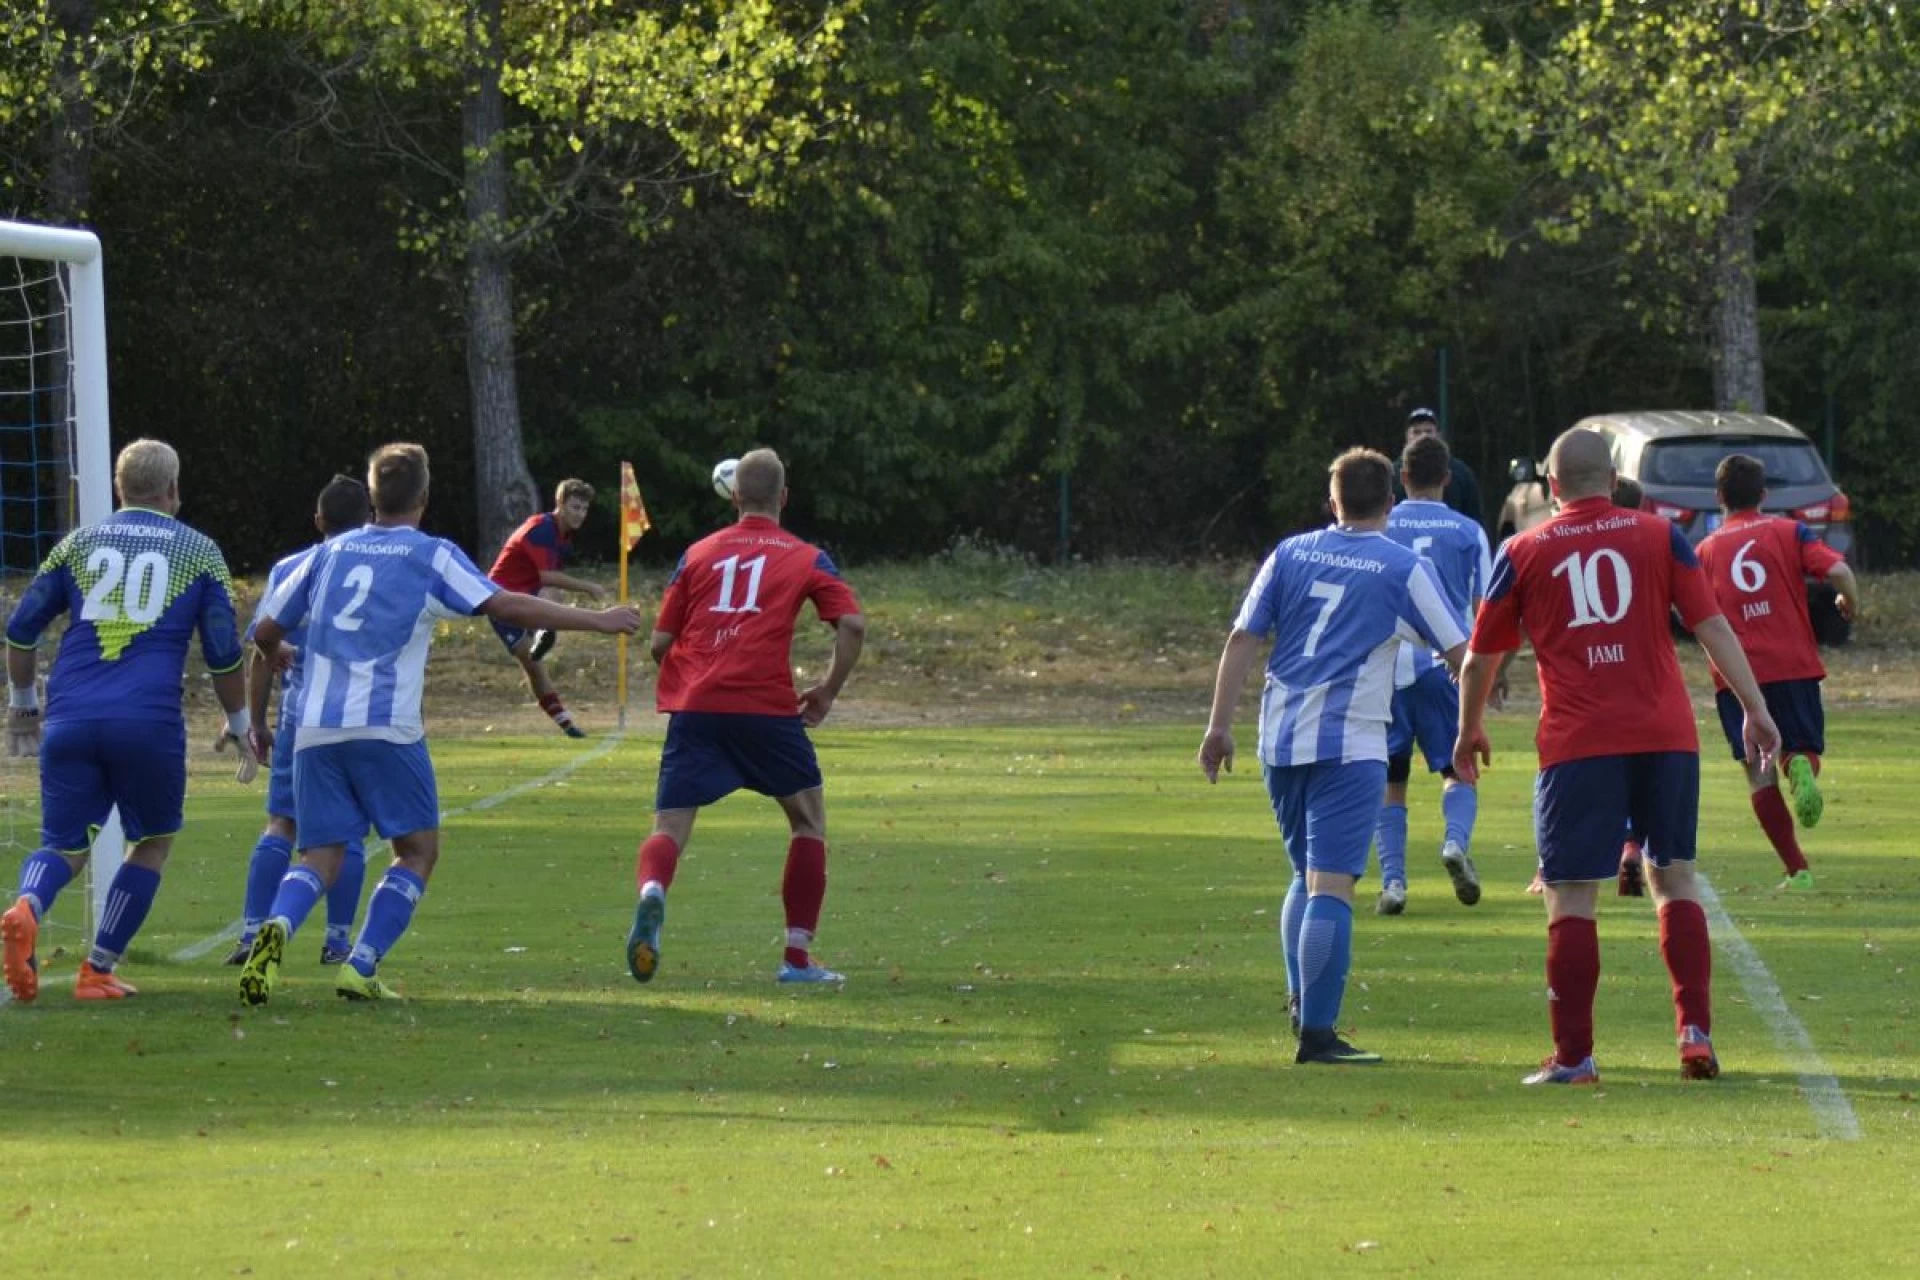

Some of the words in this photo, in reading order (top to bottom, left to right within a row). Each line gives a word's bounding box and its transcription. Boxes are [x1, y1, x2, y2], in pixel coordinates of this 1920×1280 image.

[81, 546, 169, 623] 20
[709, 554, 767, 614] 11
[1293, 549, 1309, 562] FK
[1311, 551, 1387, 573] DYMOKURY
[1551, 548, 1633, 628] 10
[1731, 539, 1767, 593] 6
[332, 564, 374, 632] 2
[1303, 580, 1346, 657] 7
[1743, 601, 1771, 622] JAMI
[1586, 643, 1626, 670] JAMI
